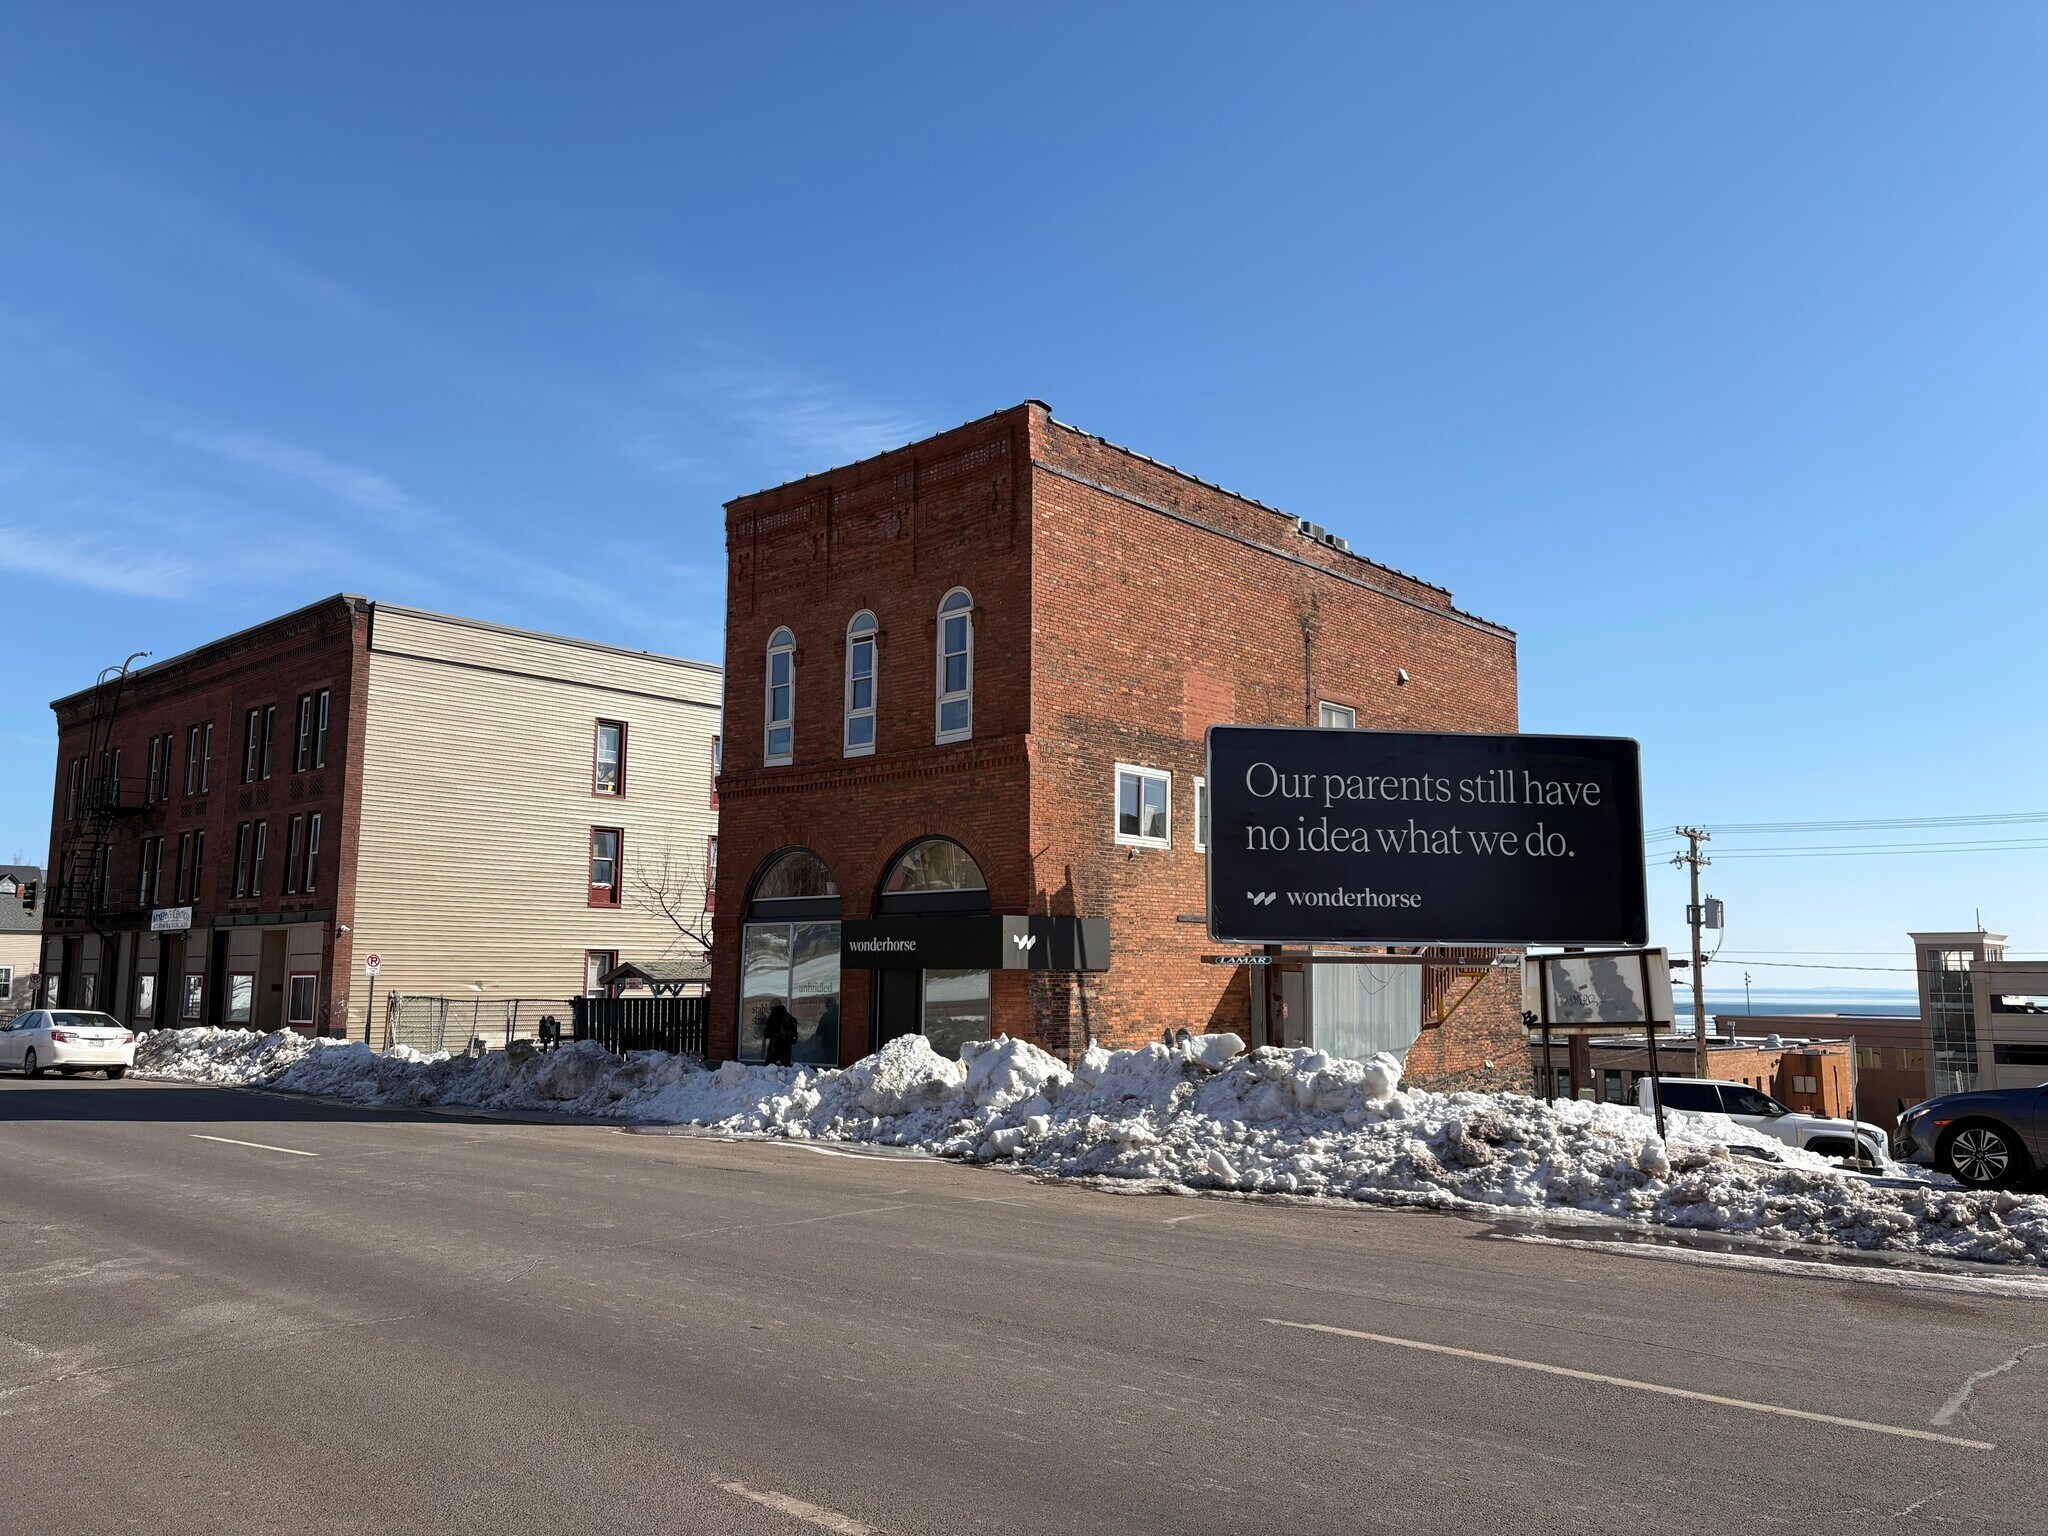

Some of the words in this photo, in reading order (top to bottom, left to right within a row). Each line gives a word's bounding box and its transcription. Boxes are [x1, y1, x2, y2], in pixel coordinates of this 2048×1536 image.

[1246, 762, 1317, 798] Our
[1323, 773, 1451, 808] parents
[1459, 769, 1518, 804] still
[1523, 770, 1601, 806] have
[1246, 825, 1291, 851] no
[1297, 816, 1371, 853] idea
[1375, 818, 1463, 854] what
[1467, 831, 1519, 856] we
[1525, 822, 1575, 857] do.
[1286, 886, 1422, 908] wonderhorse
[849, 937, 917, 952] wonderhorse
[1219, 956, 1267, 965] LAMAR
[798, 982, 833, 993] unbridled
